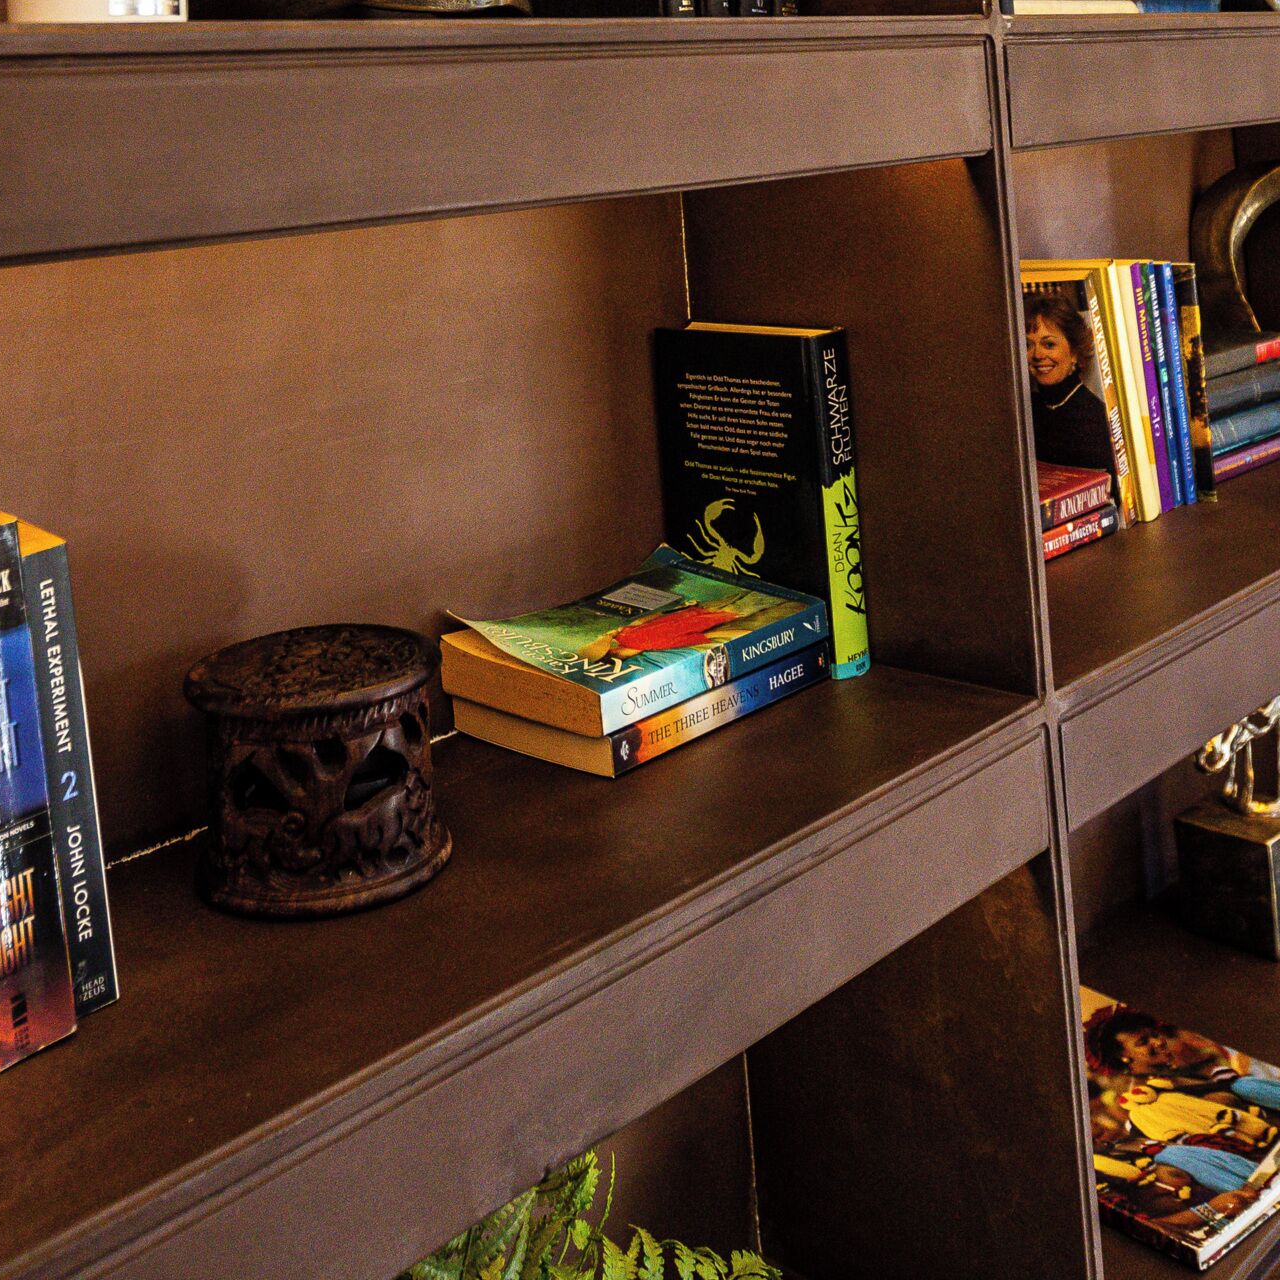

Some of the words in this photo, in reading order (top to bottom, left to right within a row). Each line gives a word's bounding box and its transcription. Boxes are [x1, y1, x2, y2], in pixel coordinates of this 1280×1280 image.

[1089, 295, 1114, 390] BLACKSTOCK
[1138, 309, 1153, 363] Mansell
[1148, 273, 1160, 319] EMERALD
[1154, 318, 1166, 363] WINDOWS
[823, 347, 845, 466] SCHWARZE
[838, 384, 853, 462] FLUTEN
[1108, 405, 1126, 452] DAWN'S
[1117, 449, 1131, 478] LIGHT
[834, 531, 845, 573] DEAN
[835, 483, 864, 616] KOONTZ
[1044, 535, 1070, 553] TWISTED
[1069, 521, 1099, 543] INNOCENCE
[38, 577, 59, 644] LETHAL
[522, 648, 574, 675] Karen
[740, 627, 797, 663] KINGSBURY
[46, 644, 73, 755] EXPERIMENT
[620, 681, 679, 717] SUMMER
[768, 663, 805, 691] HAGEE
[647, 724, 673, 746] THE
[673, 705, 710, 735] THREE
[711, 683, 761, 720] HEAVENS
[59, 770, 80, 802] 2
[9, 820, 35, 837] NOVELS
[66, 824, 86, 879] JOHN
[73, 879, 94, 944] LOCKE
[80, 975, 106, 993] HEAD
[82, 984, 107, 1002] ZEUS
